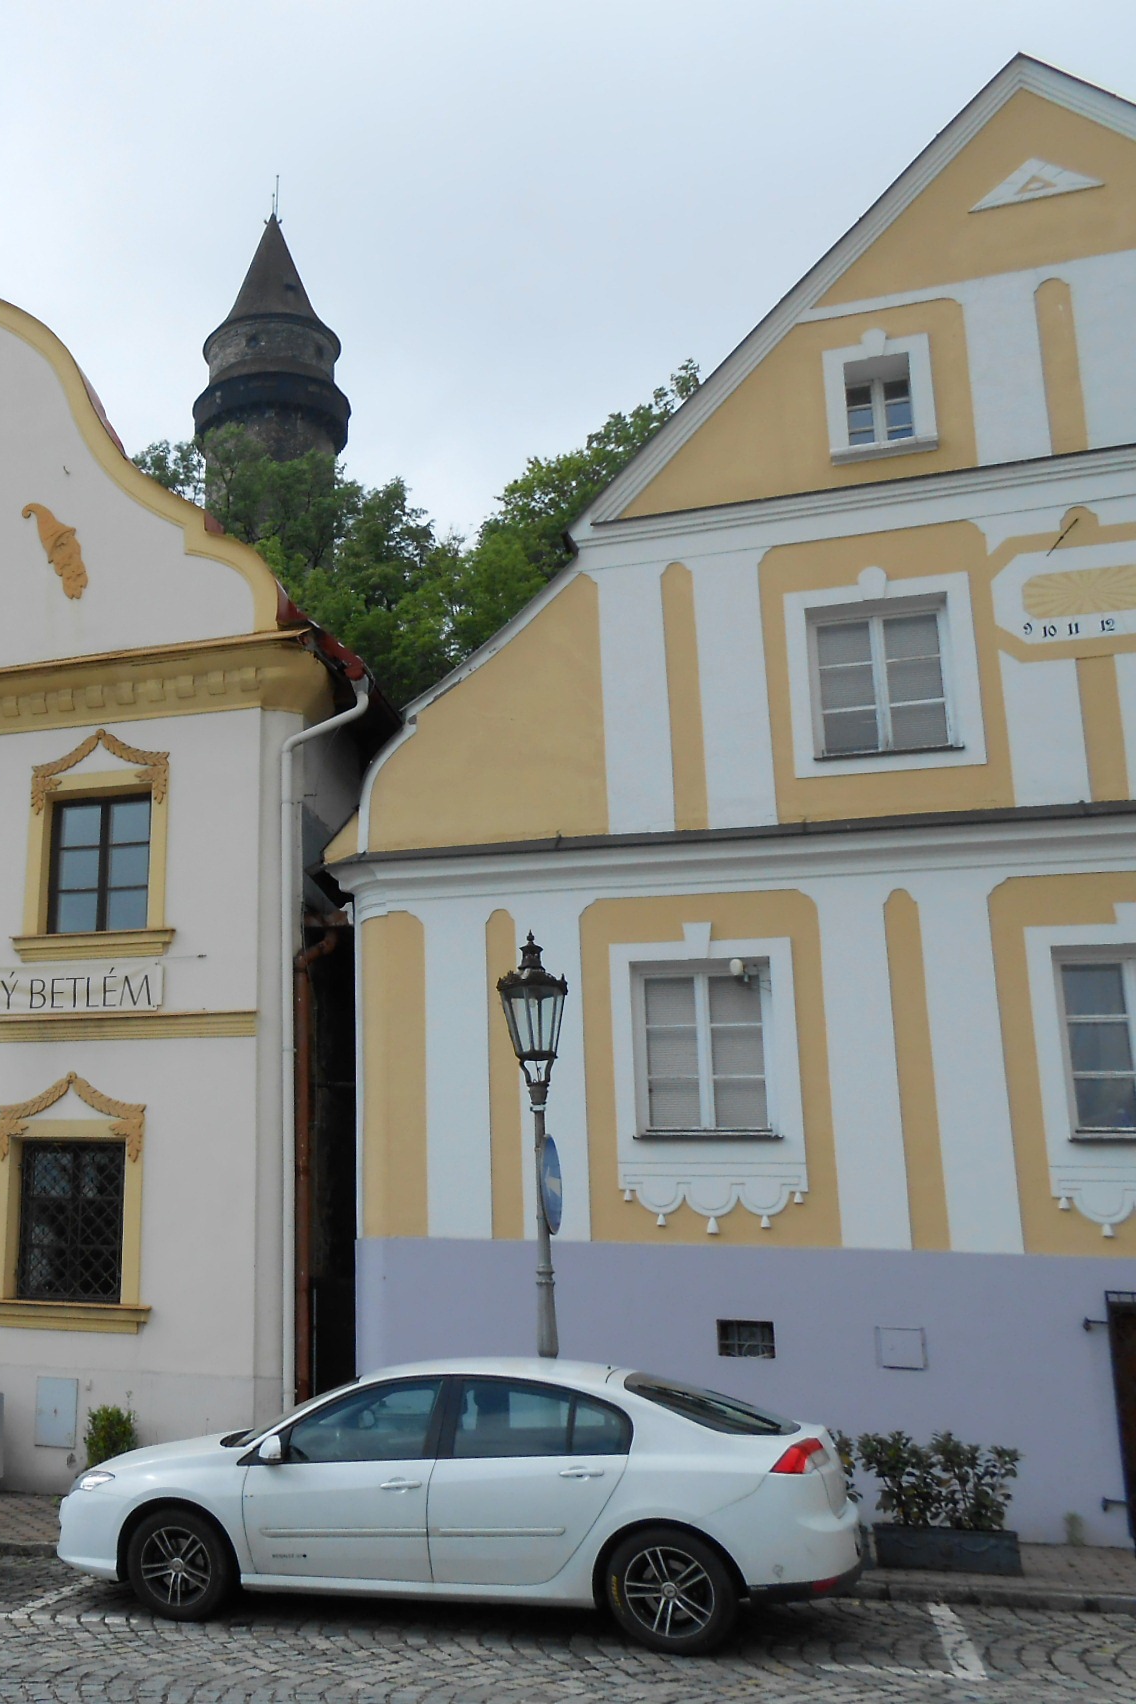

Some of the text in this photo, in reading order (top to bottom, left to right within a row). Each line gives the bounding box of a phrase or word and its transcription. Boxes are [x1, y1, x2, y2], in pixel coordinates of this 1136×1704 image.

[1023, 618, 1115, 638] 9 10 11 12
[29, 967, 152, 1009] BETLÉM
